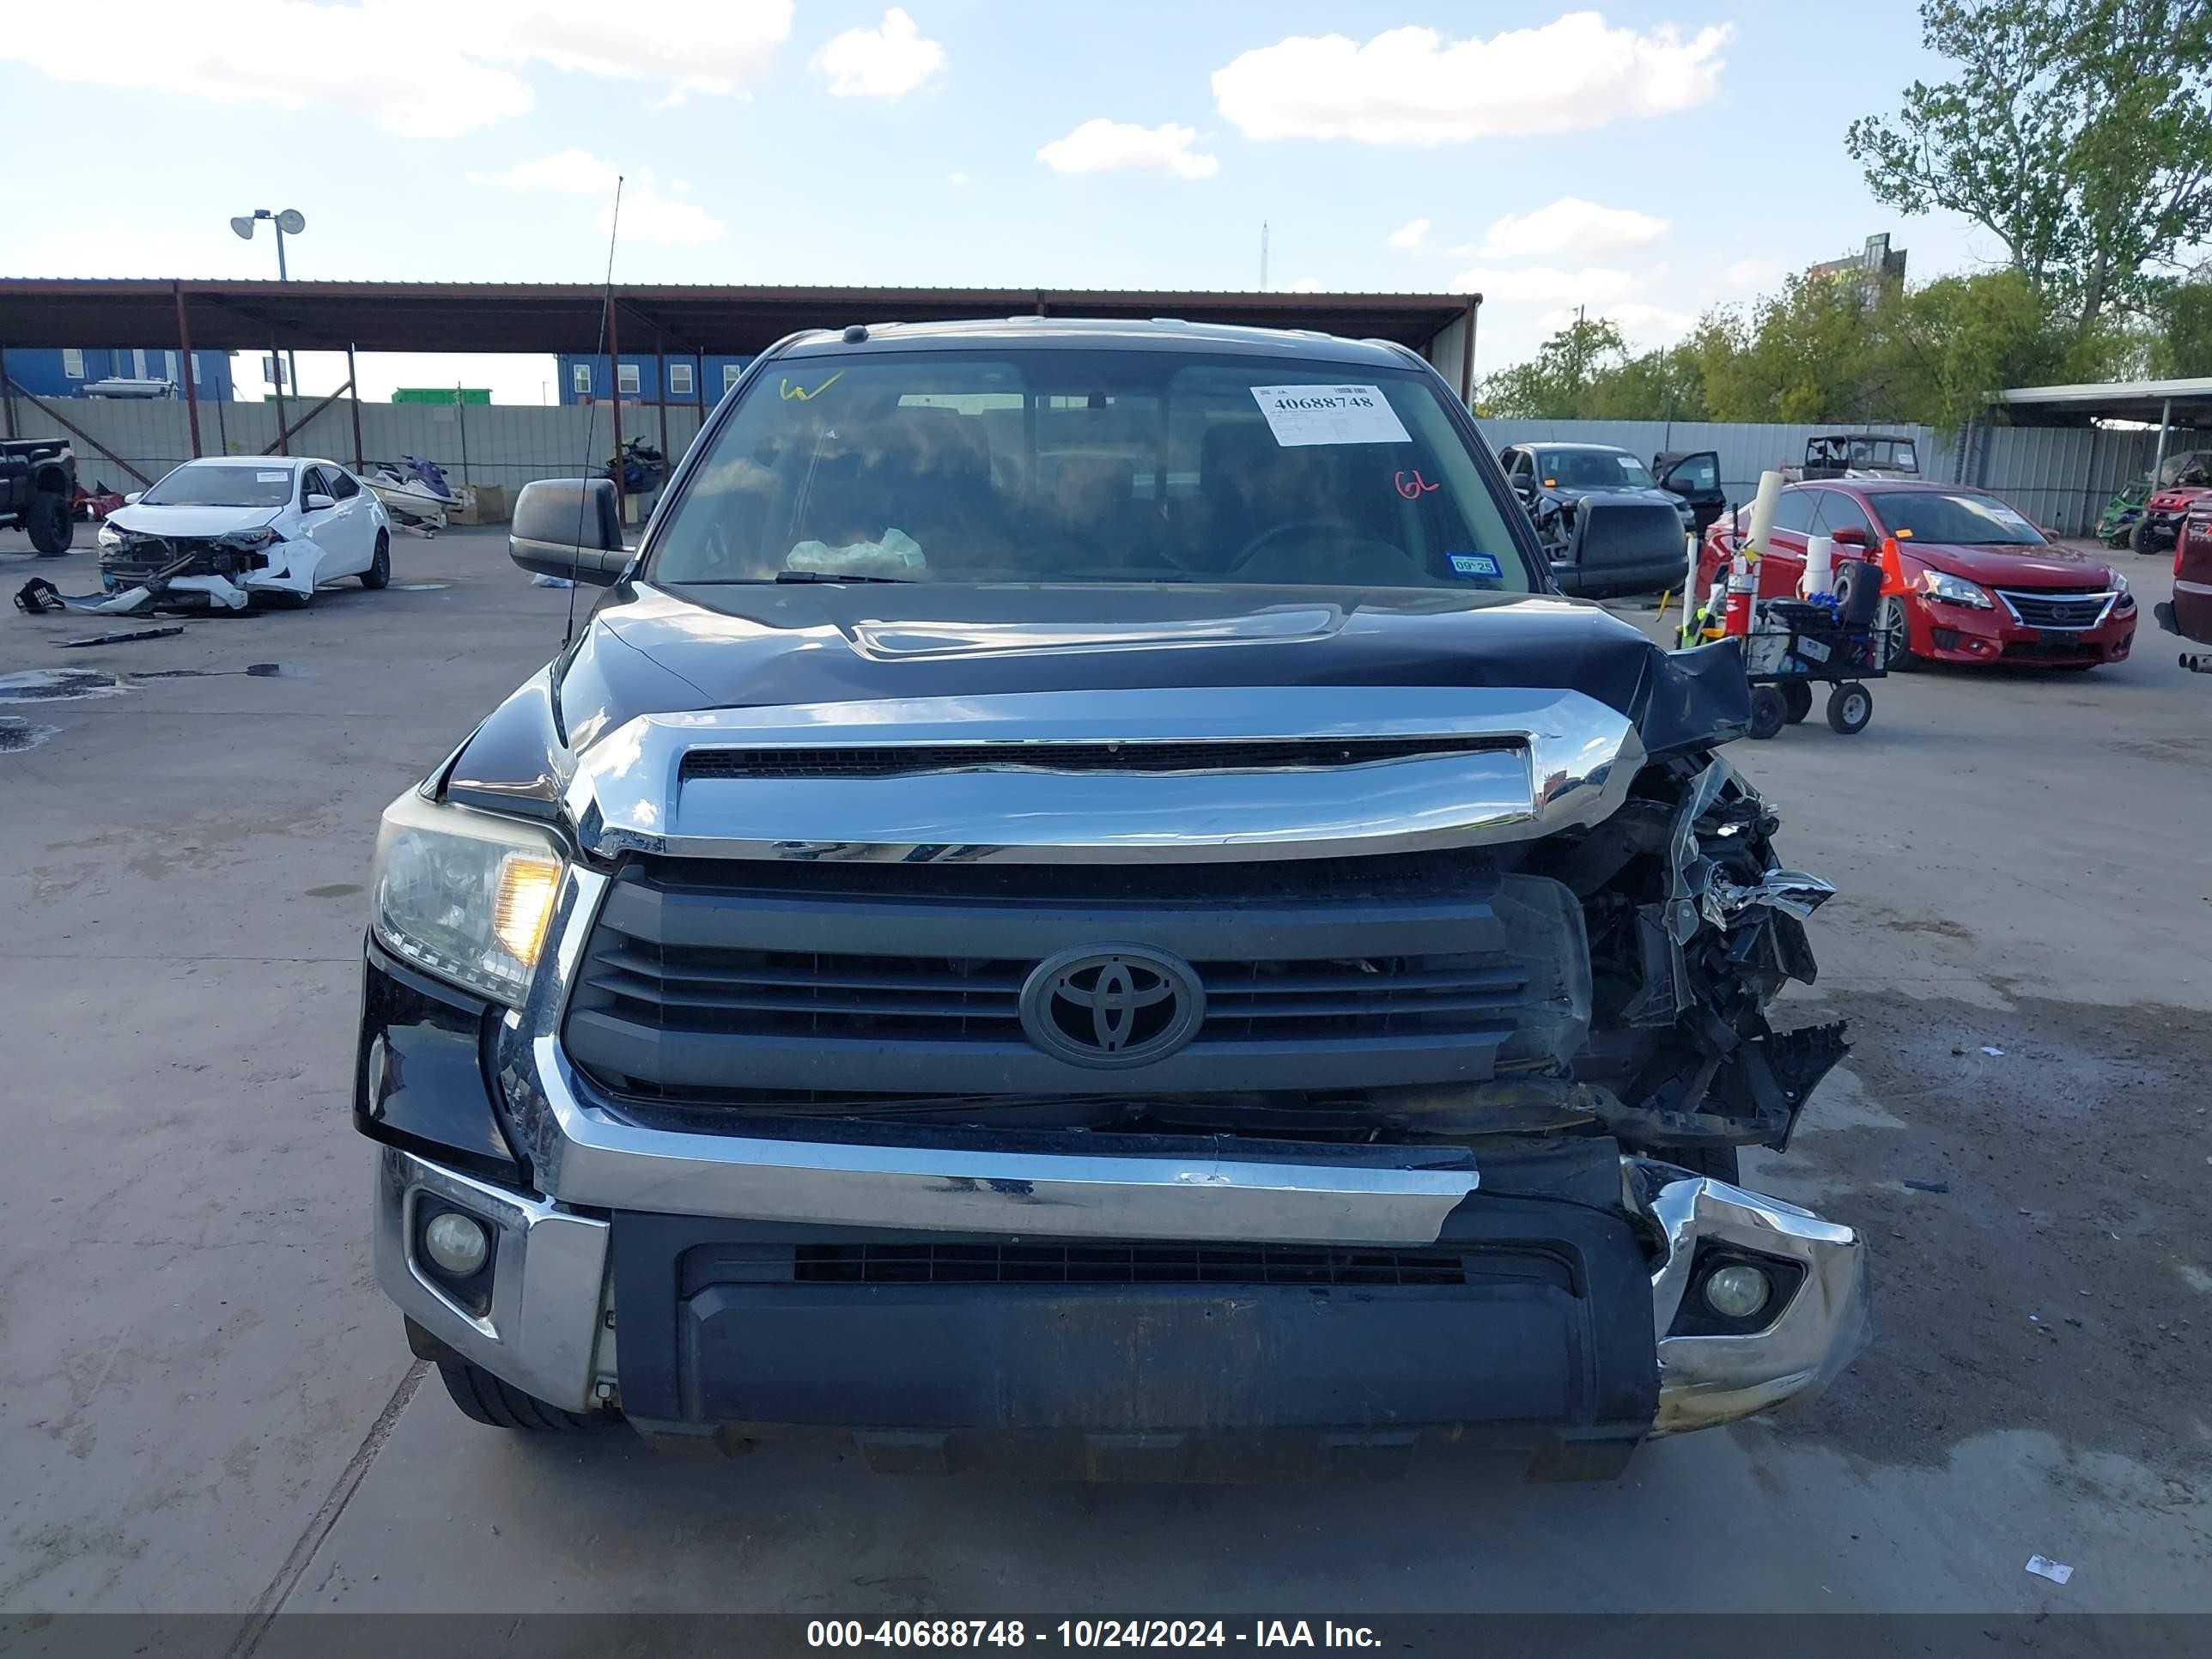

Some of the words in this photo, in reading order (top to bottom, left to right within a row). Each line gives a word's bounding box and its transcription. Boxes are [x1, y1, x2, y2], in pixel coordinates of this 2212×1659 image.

[1274, 397, 1375, 410] 40688748
[1455, 562, 1472, 570] 09
[1477, 562, 1493, 571] 25
